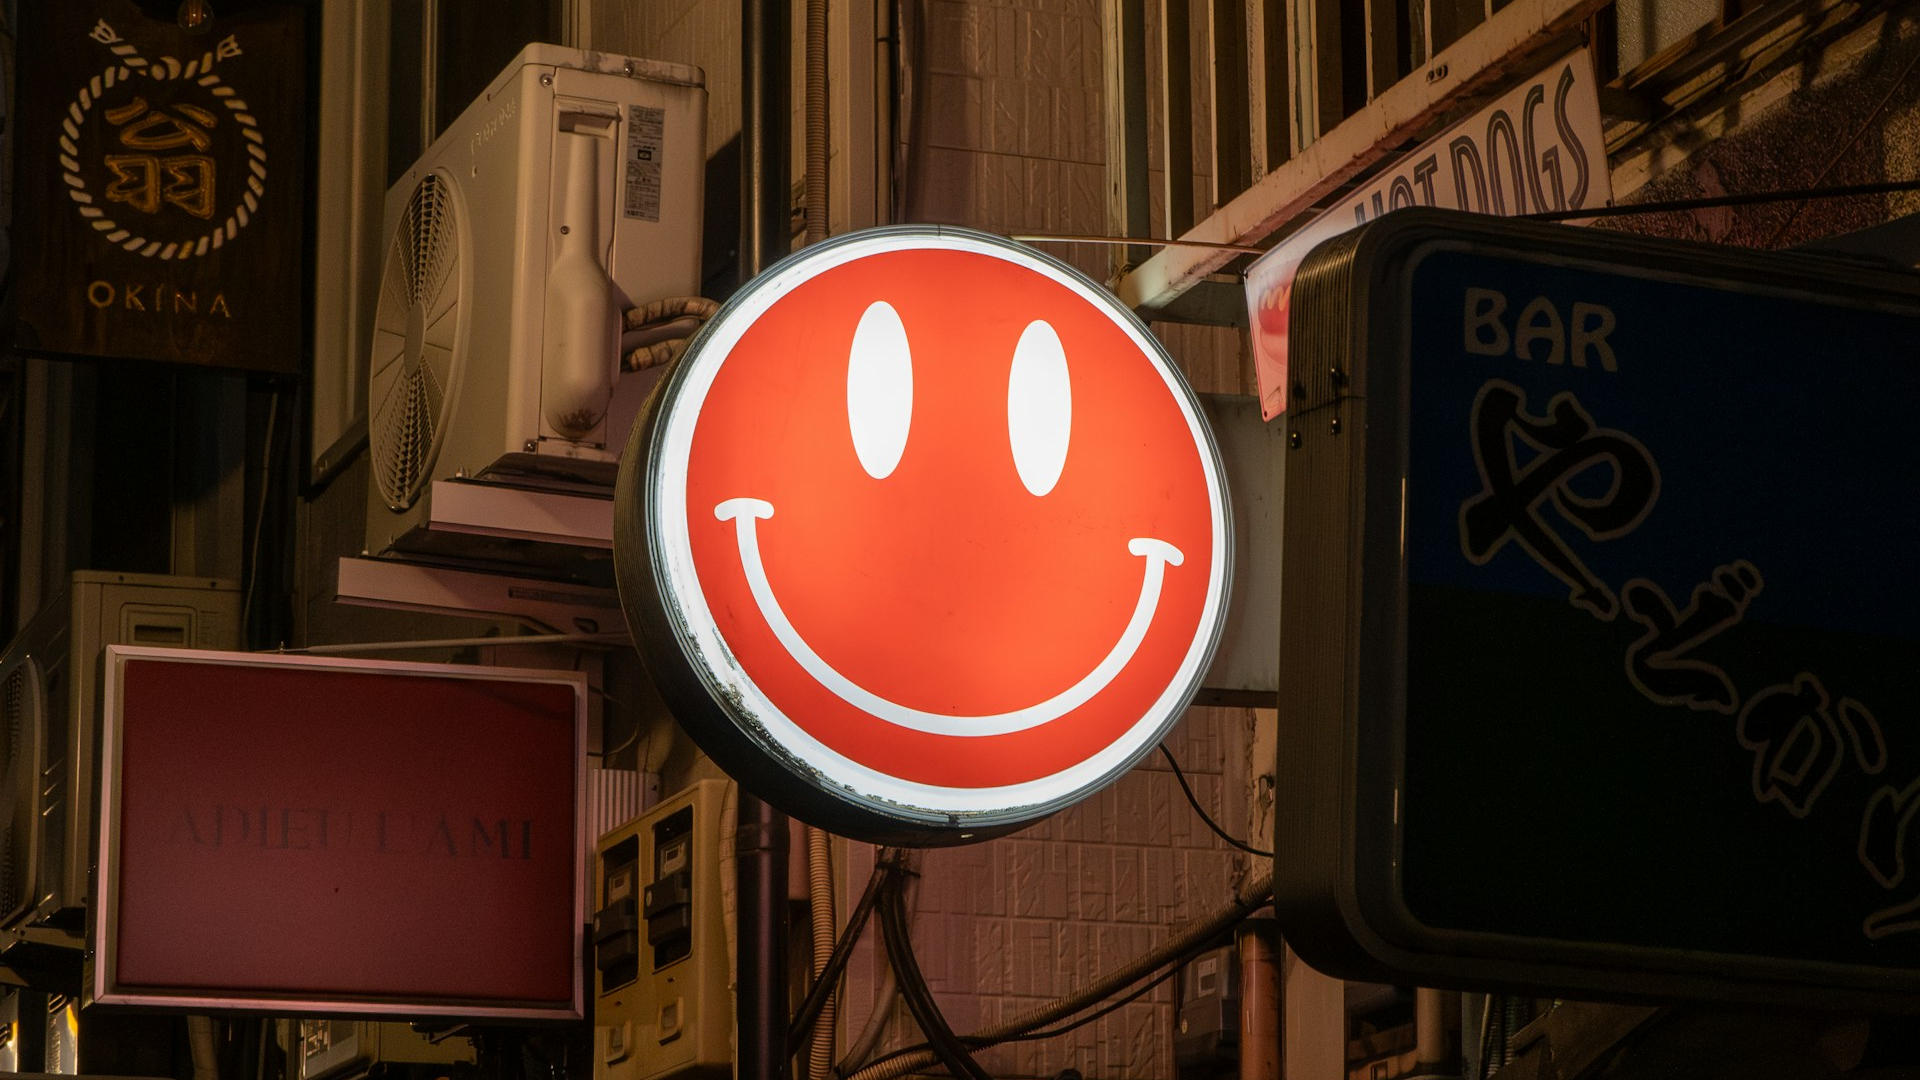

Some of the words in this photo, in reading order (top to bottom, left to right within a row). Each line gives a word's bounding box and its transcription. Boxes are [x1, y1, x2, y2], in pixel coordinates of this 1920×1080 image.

[104, 96, 218, 220] 翁
[1450, 64, 1589, 217] DOGS
[87, 280, 231, 318] OKINA
[1464, 287, 1618, 373] BAR
[170, 803, 353, 850] ADIEU
